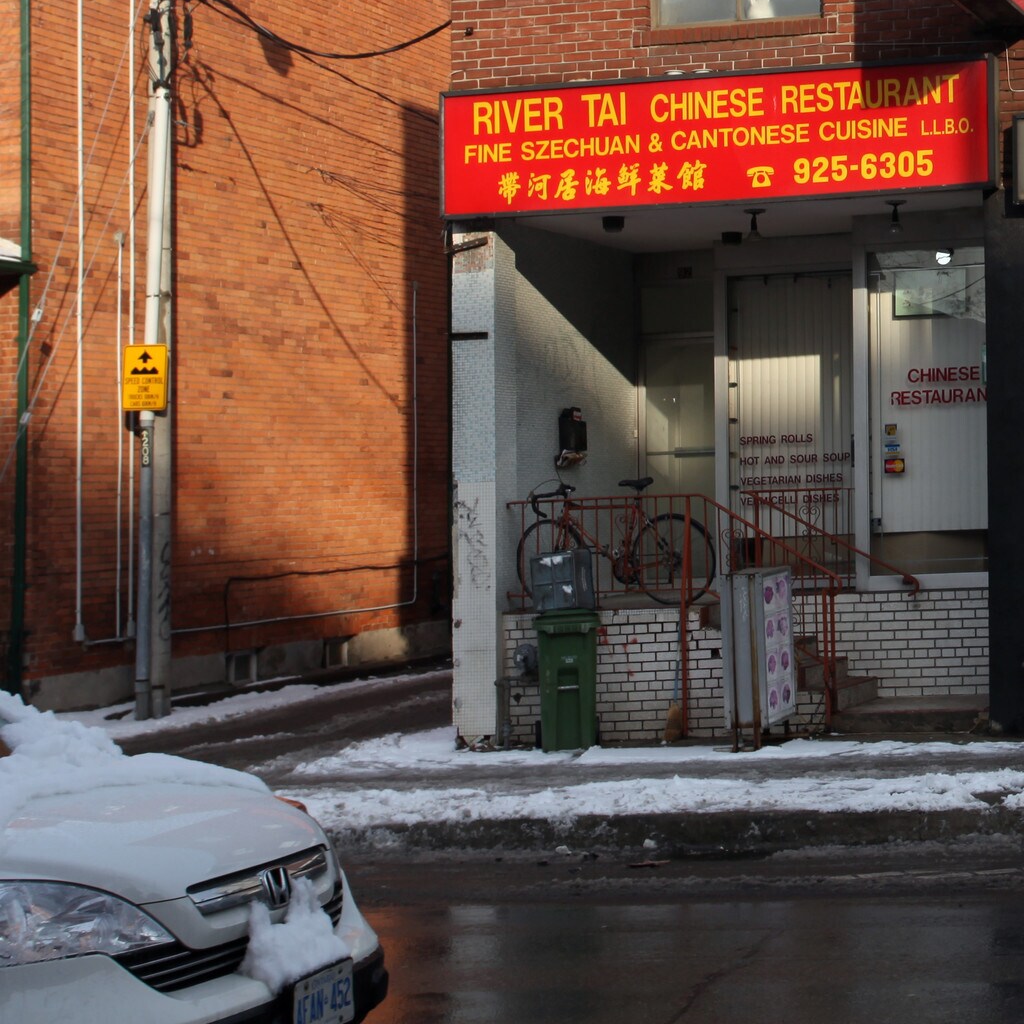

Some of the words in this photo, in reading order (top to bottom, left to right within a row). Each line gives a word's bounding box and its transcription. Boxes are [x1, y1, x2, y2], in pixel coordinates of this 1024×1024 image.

[473, 97, 564, 135] RIVER
[581, 91, 627, 127] TAI
[650, 87, 764, 123] CHINESE
[781, 74, 960, 113] RESTAURANT
[464, 142, 512, 164] FINE
[521, 135, 641, 161] SZECHUAN
[648, 132, 663, 153] &
[670, 123, 809, 151] CANTONESE
[818, 117, 908, 141] CUISINE
[921, 118, 974, 136] L.L.B.O.
[793, 149, 934, 184] 925-6305
[907, 365, 980, 383] CHINESE
[890, 387, 988, 406] RESTAURAN
[739, 435, 776, 446] SPRING
[781, 433, 813, 444] ROLLS
[141, 437, 150, 465] 208
[739, 456, 760, 466] HOT
[764, 455, 785, 465] AND
[789, 453, 818, 464] SOUR
[822, 451, 851, 462] SOUP
[740, 475, 801, 486] VEGETARIAN
[805, 472, 843, 484] DISHES
[802, 492, 841, 505] DISHES
[330, 976, 351, 1012] 452
